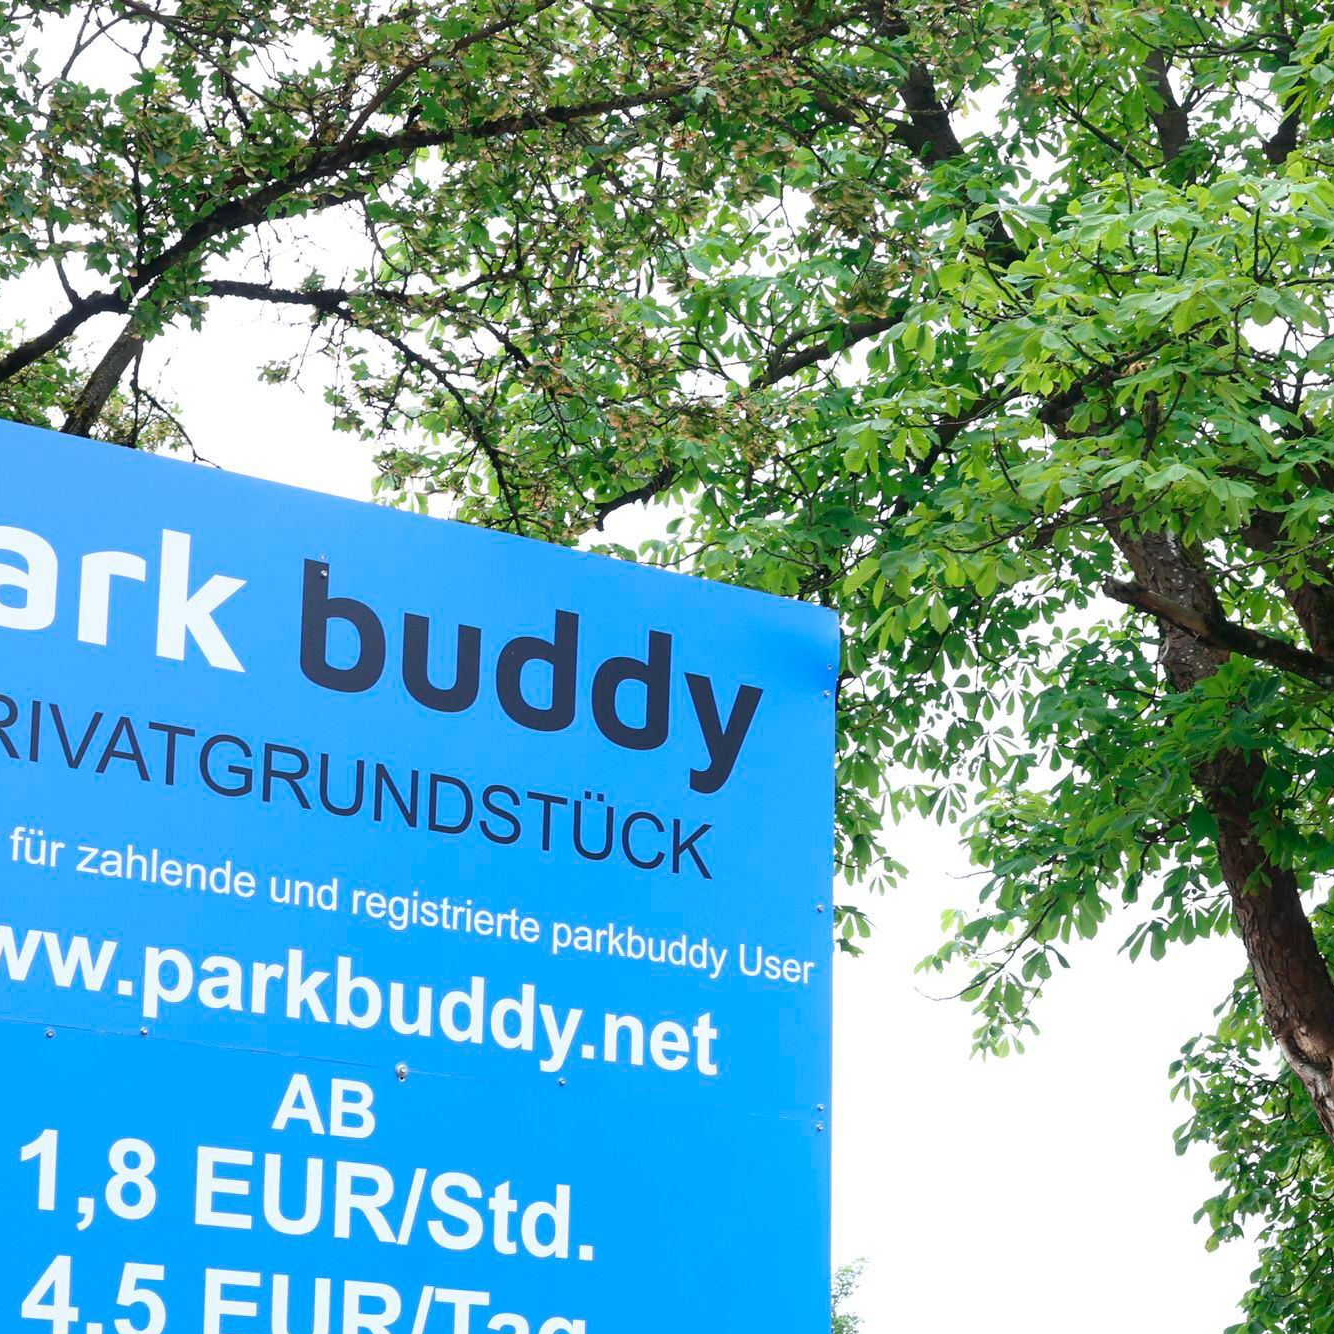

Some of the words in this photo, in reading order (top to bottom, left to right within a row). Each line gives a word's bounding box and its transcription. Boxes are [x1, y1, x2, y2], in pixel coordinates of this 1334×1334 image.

[301, 558, 764, 794] buddy
[9, 826, 66, 868] für
[75, 844, 256, 898] zahlende
[270, 876, 339, 911] und
[352, 889, 540, 943] registrierte
[552, 922, 728, 979] parkbuddy
[739, 943, 816, 984] User
[271, 1073, 376, 1139] AB
[20, 1128, 157, 1231] 1,8
[194, 1145, 594, 1261] EUR/Std.
